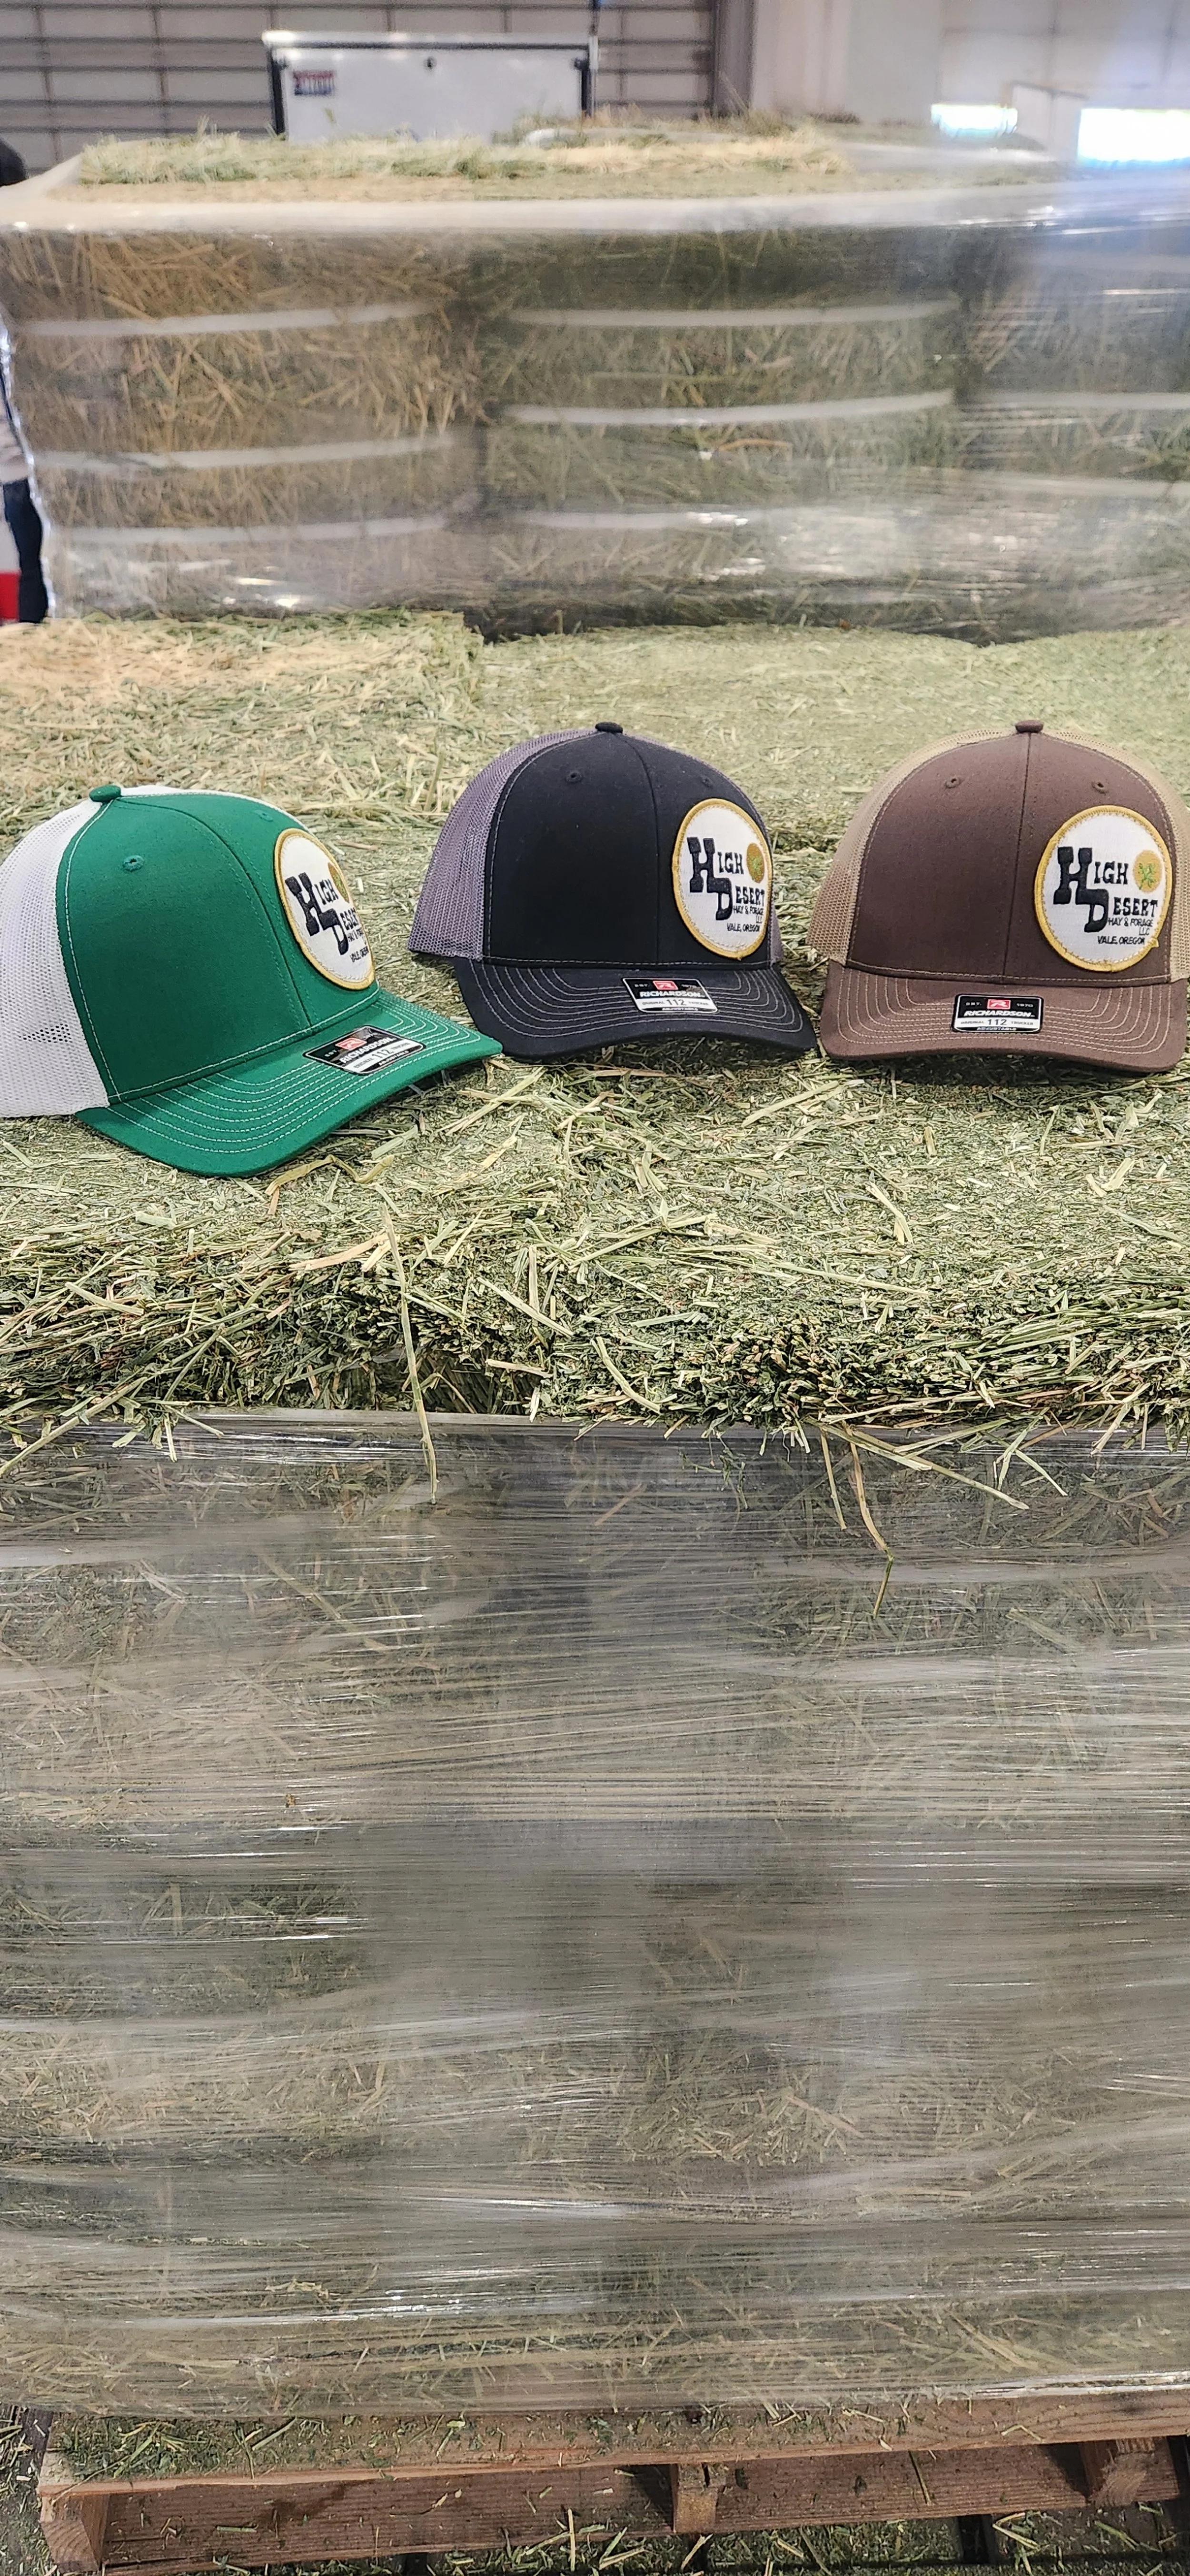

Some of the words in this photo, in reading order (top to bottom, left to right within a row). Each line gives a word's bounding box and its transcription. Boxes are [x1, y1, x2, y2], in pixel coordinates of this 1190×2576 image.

[687, 836, 744, 893] HIGH
[1053, 846, 1129, 905] HIGH
[285, 872, 339, 937] HIGH
[707, 877, 765, 921] DESERT
[1075, 888, 1158, 933] DESERT
[1108, 917, 1123, 926] HAY
[1124, 918, 1129, 926] &
[1130, 918, 1153, 927] FORAGE
[1139, 928, 1150, 936] LLC
[1119, 936, 1145, 945] OREGON
[339, 1037, 393, 1064] RICHARDSON
[372, 1049, 394, 1059] 112
